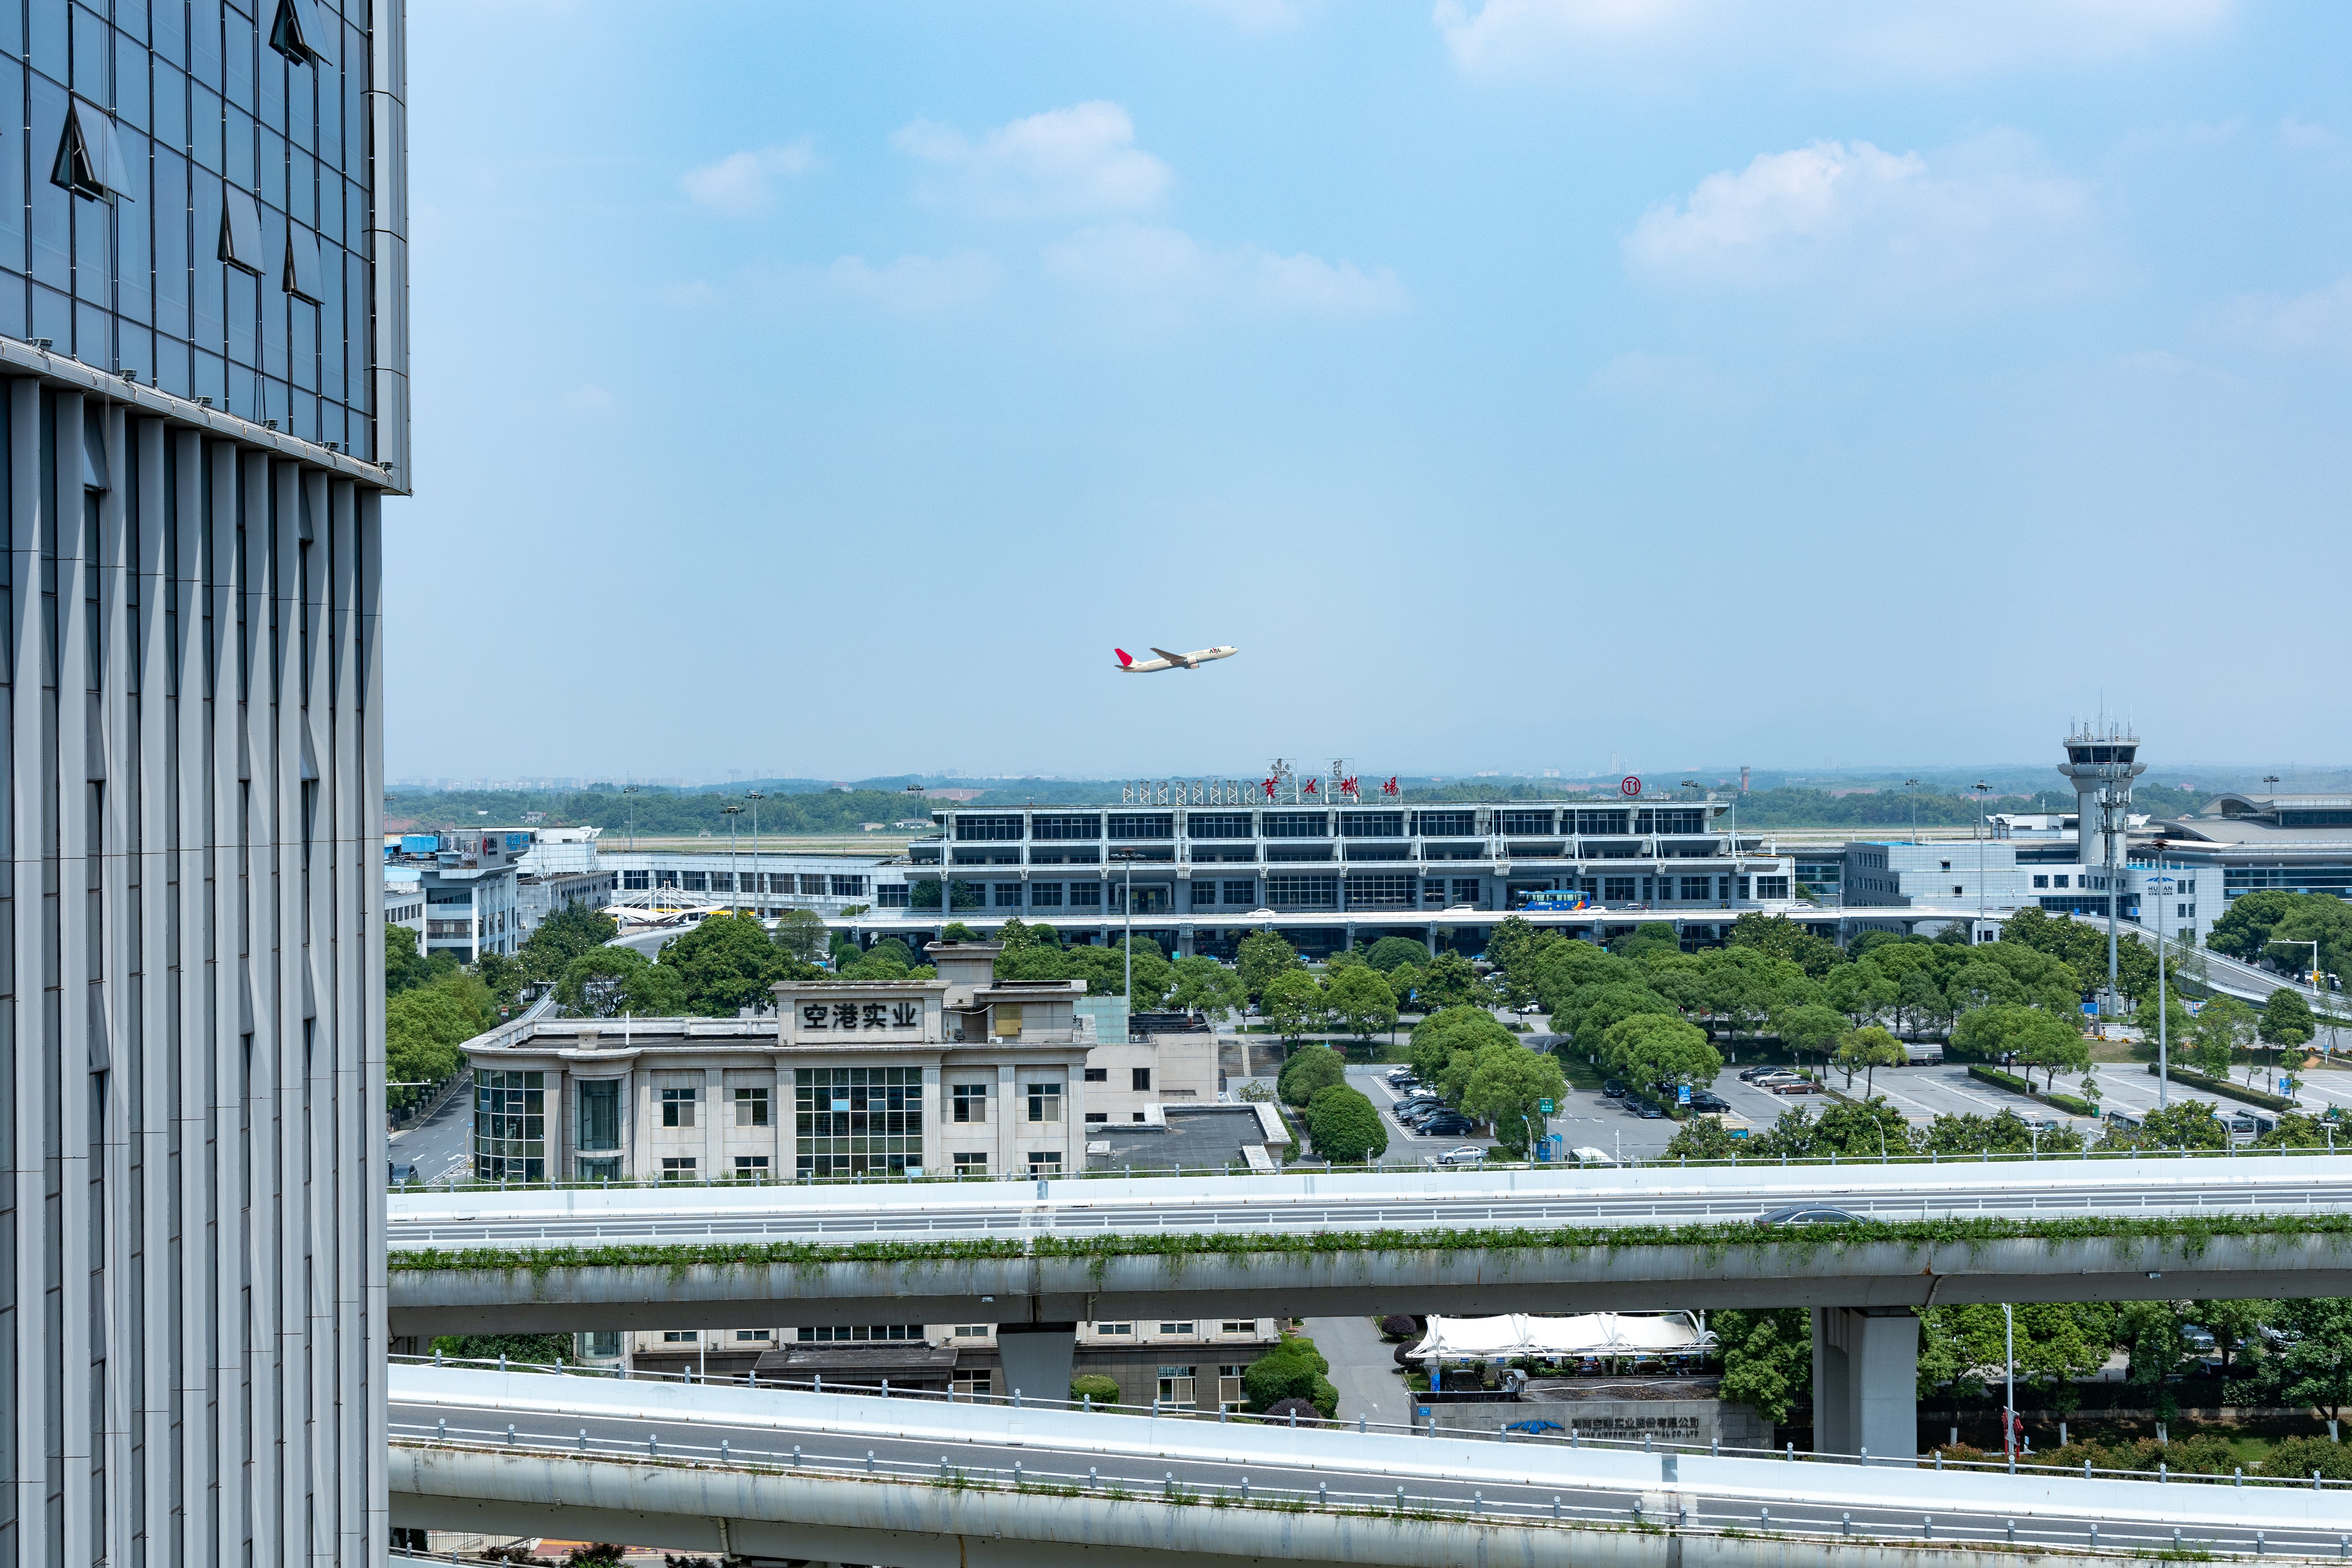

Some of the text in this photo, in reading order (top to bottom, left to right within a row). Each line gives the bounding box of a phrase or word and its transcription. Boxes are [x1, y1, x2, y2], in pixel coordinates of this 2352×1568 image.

[1626, 781, 1638, 792] T1
[804, 1003, 916, 1029] 空港实业
[1572, 1417, 1699, 1428] 湖南空港实业股份有限公司
[1597, 1431, 1627, 1439] AIRPORT
